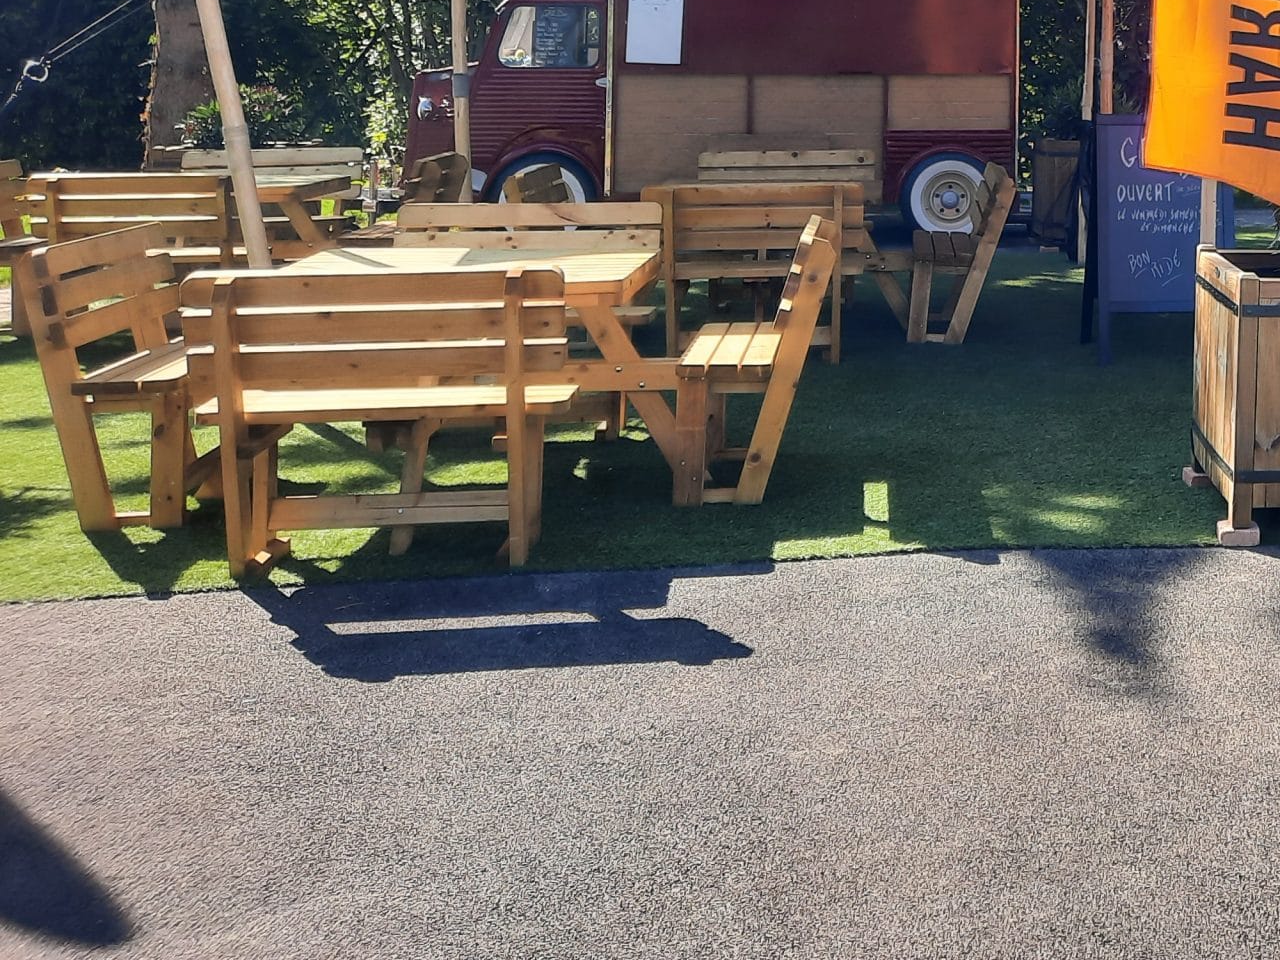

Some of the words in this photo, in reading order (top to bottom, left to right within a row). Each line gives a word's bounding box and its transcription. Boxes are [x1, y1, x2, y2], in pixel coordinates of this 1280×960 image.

[1116, 181, 1175, 203] OUVERT
[1127, 248, 1151, 274] BON
[1150, 247, 1181, 279] RIDE
